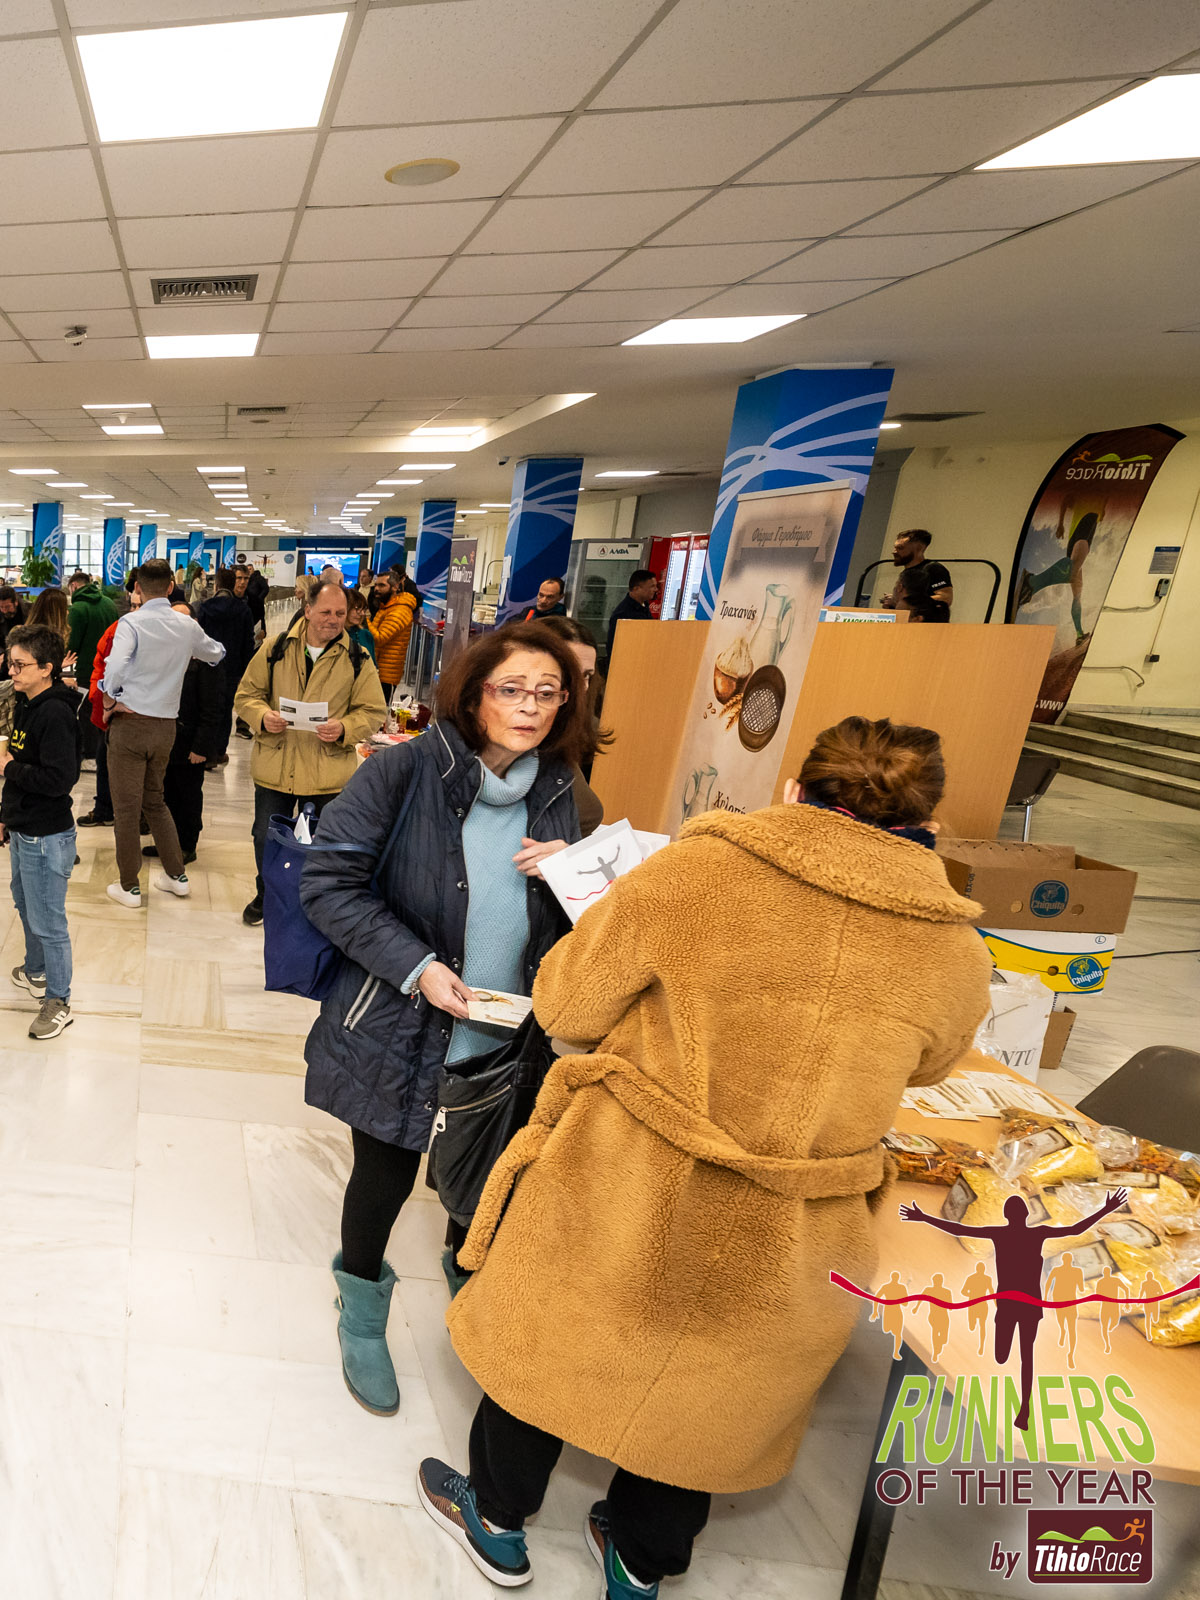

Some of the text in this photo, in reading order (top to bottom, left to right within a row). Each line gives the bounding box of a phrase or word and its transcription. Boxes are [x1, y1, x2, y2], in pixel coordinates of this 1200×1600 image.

[720, 600, 757, 621] Τραχανάς
[1030, 900, 1065, 911] Chiquita
[1071, 969, 1104, 985] Chiquita
